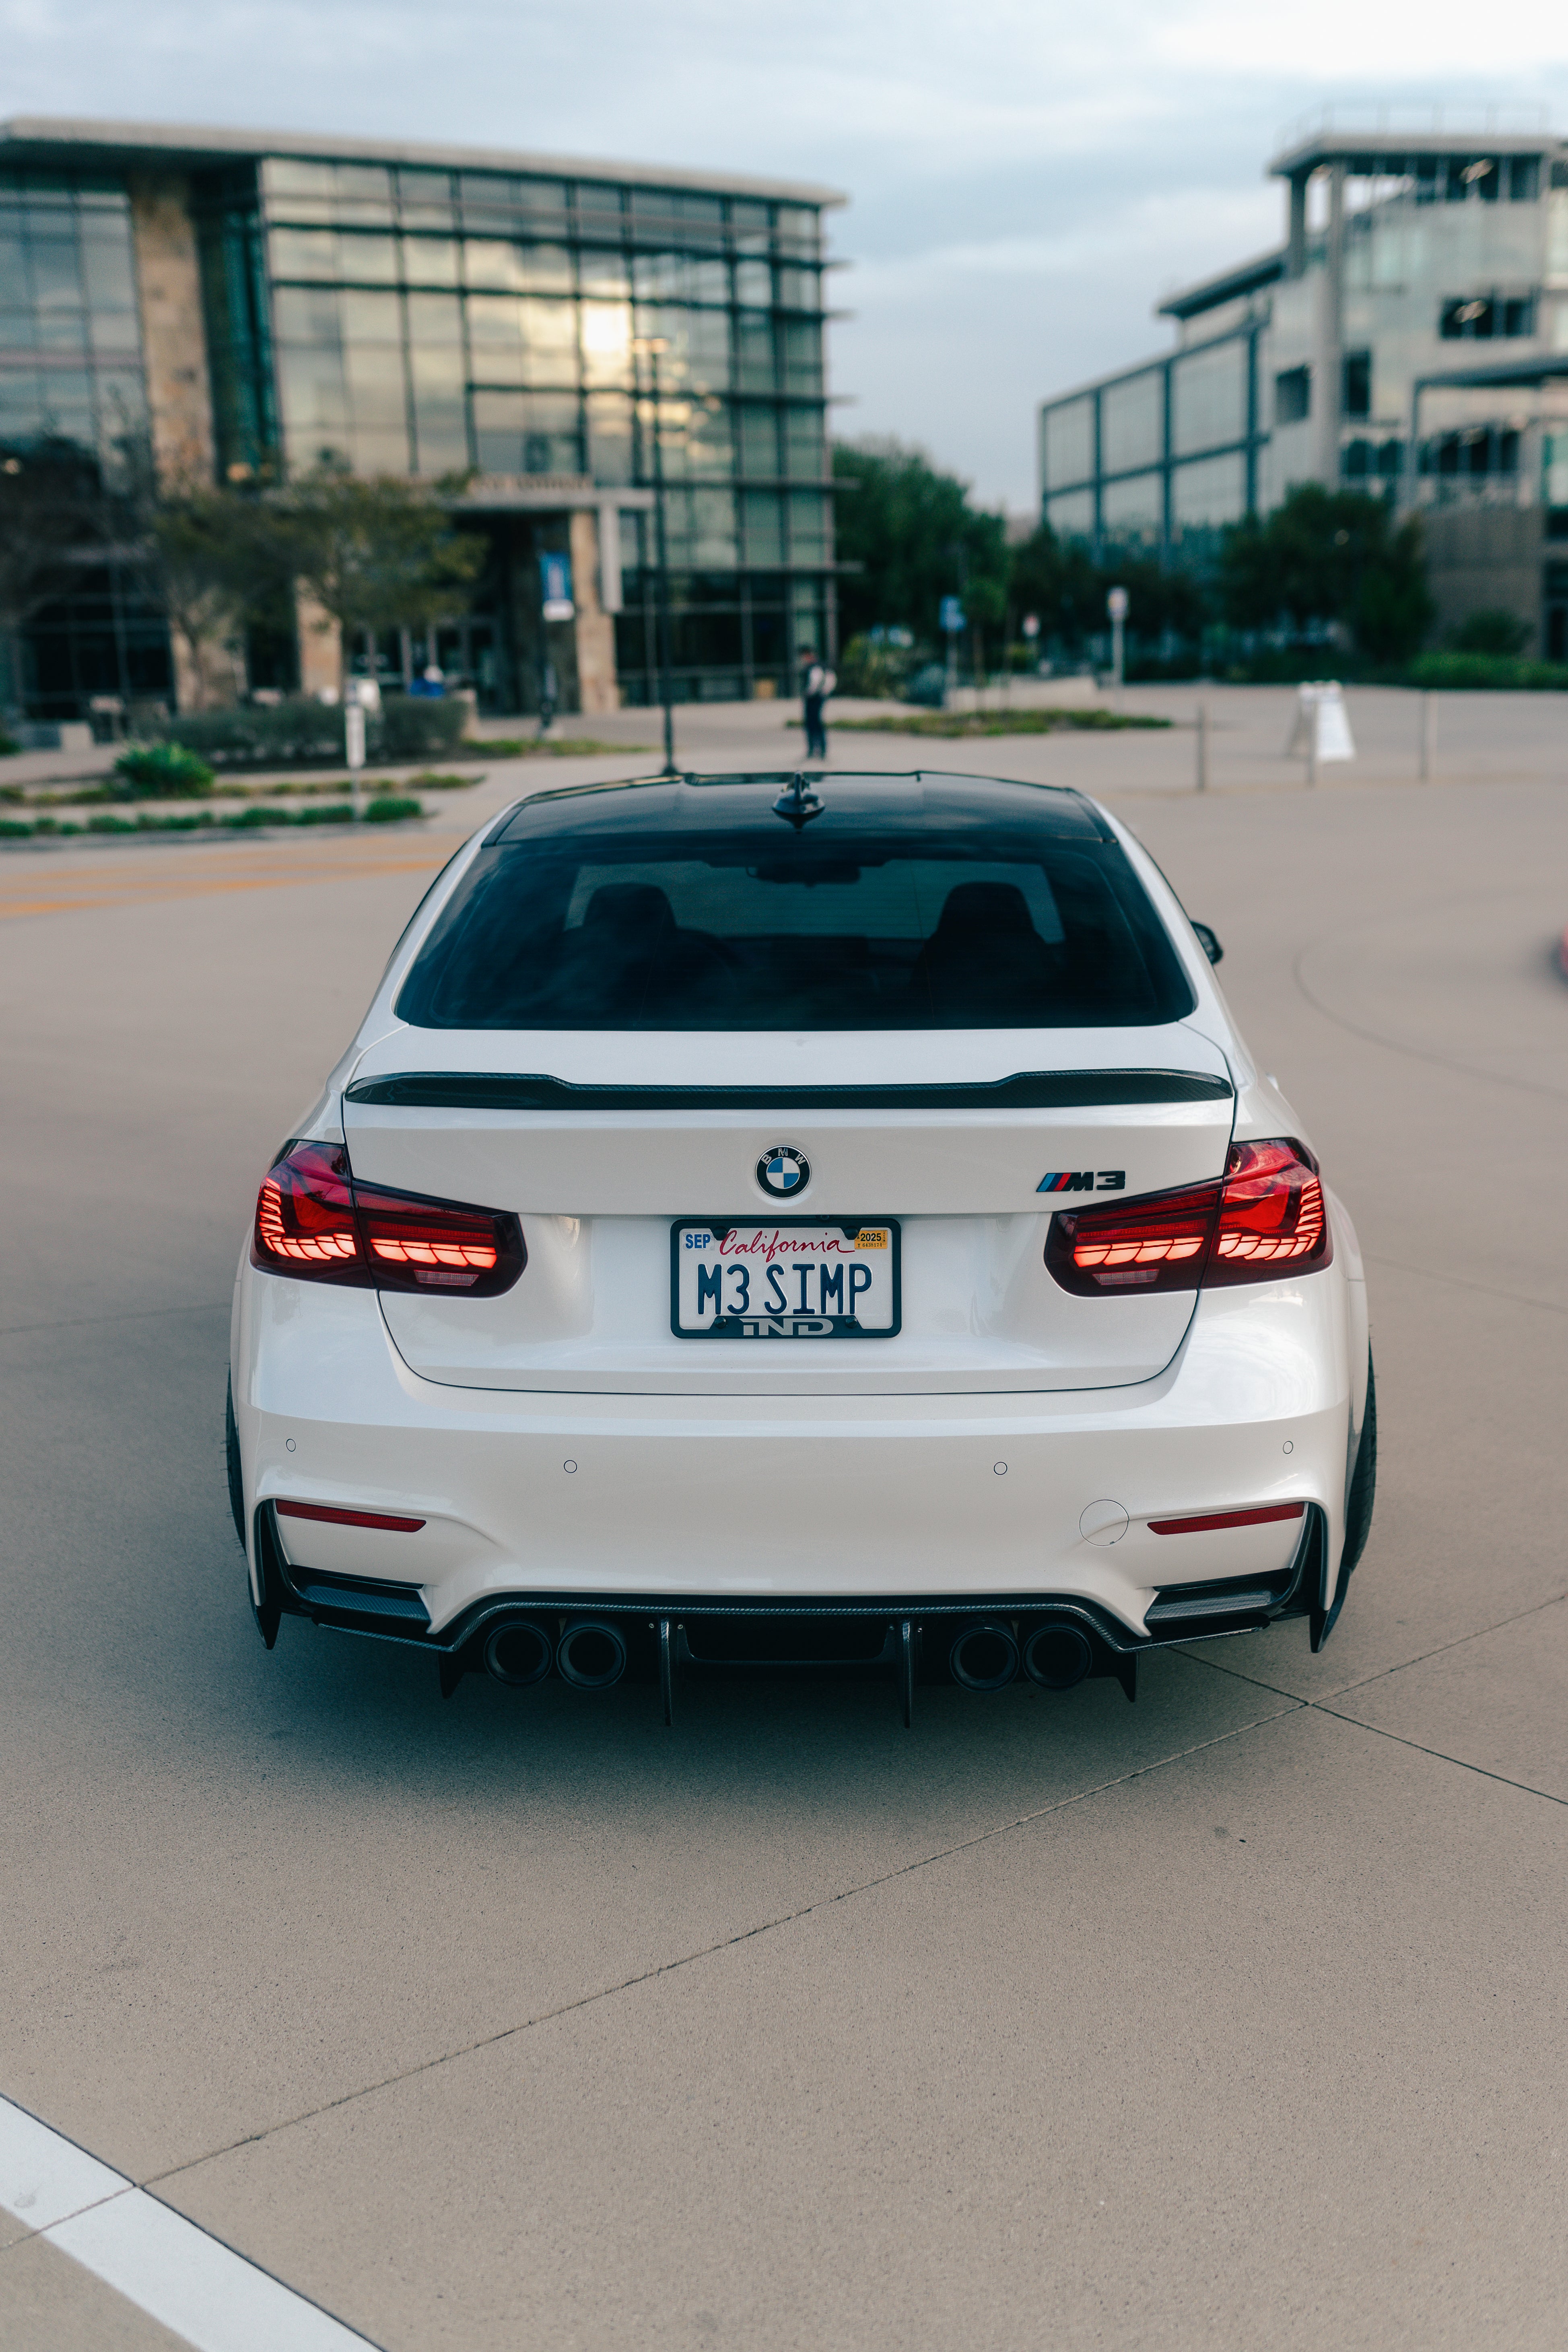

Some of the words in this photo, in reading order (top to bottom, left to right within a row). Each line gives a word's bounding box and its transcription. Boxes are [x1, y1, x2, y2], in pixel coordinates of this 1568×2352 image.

[761, 1148, 806, 1165] BMW
[1061, 1170, 1125, 1191] M3
[686, 1234, 711, 1249] SEP
[860, 1233, 882, 1241] 2025
[720, 1230, 855, 1263] California
[698, 1264, 750, 1315] M3
[764, 1264, 872, 1315] SIMP
[739, 1318, 833, 1335] IND
